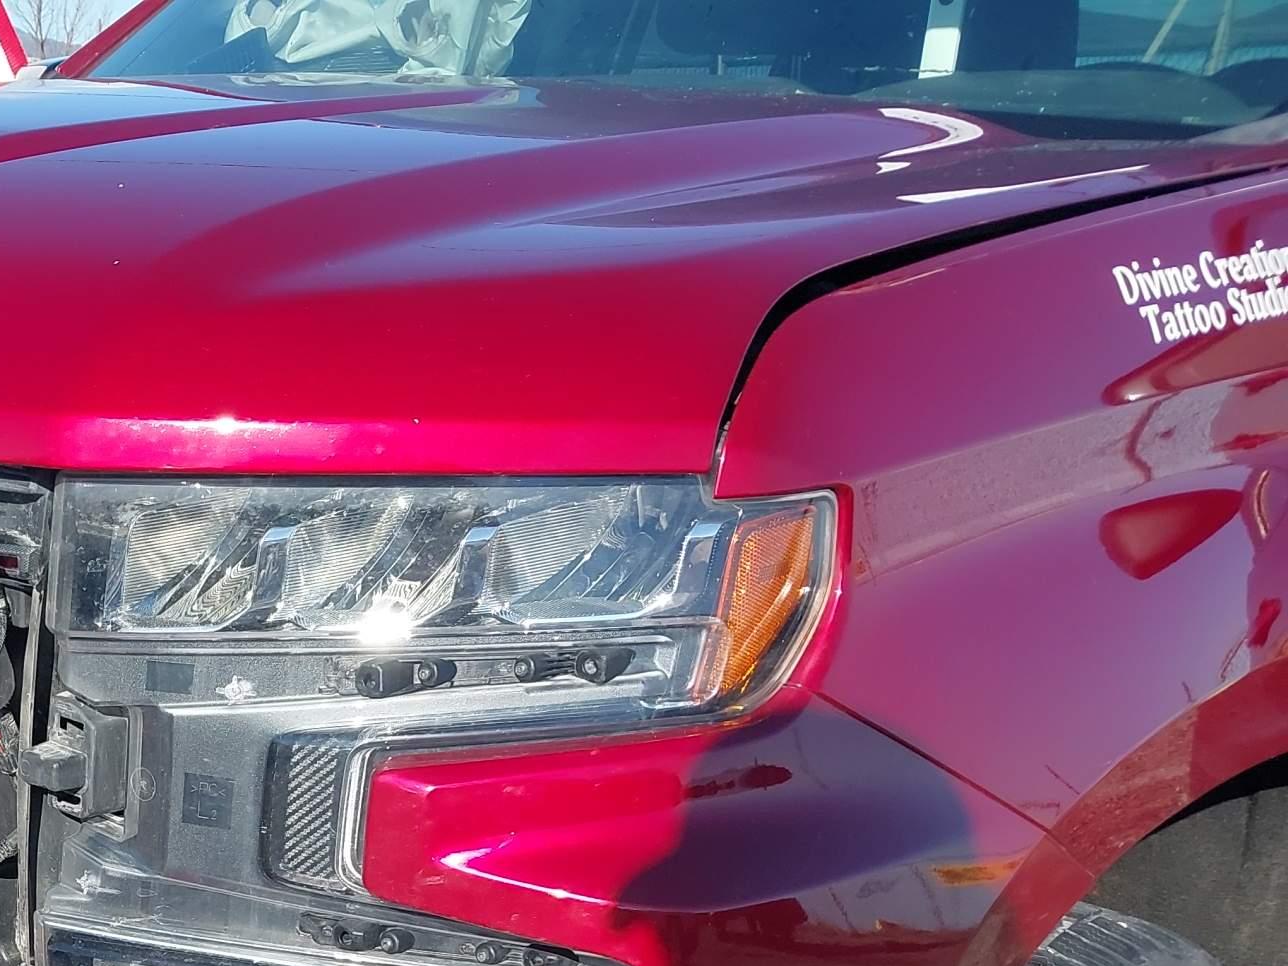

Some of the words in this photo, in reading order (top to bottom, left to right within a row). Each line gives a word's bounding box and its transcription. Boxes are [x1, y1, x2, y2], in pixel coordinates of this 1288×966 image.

[1112, 257, 1200, 305] Divine
[1139, 300, 1227, 344] Tattoo
[1226, 276, 1288, 326] Studi
